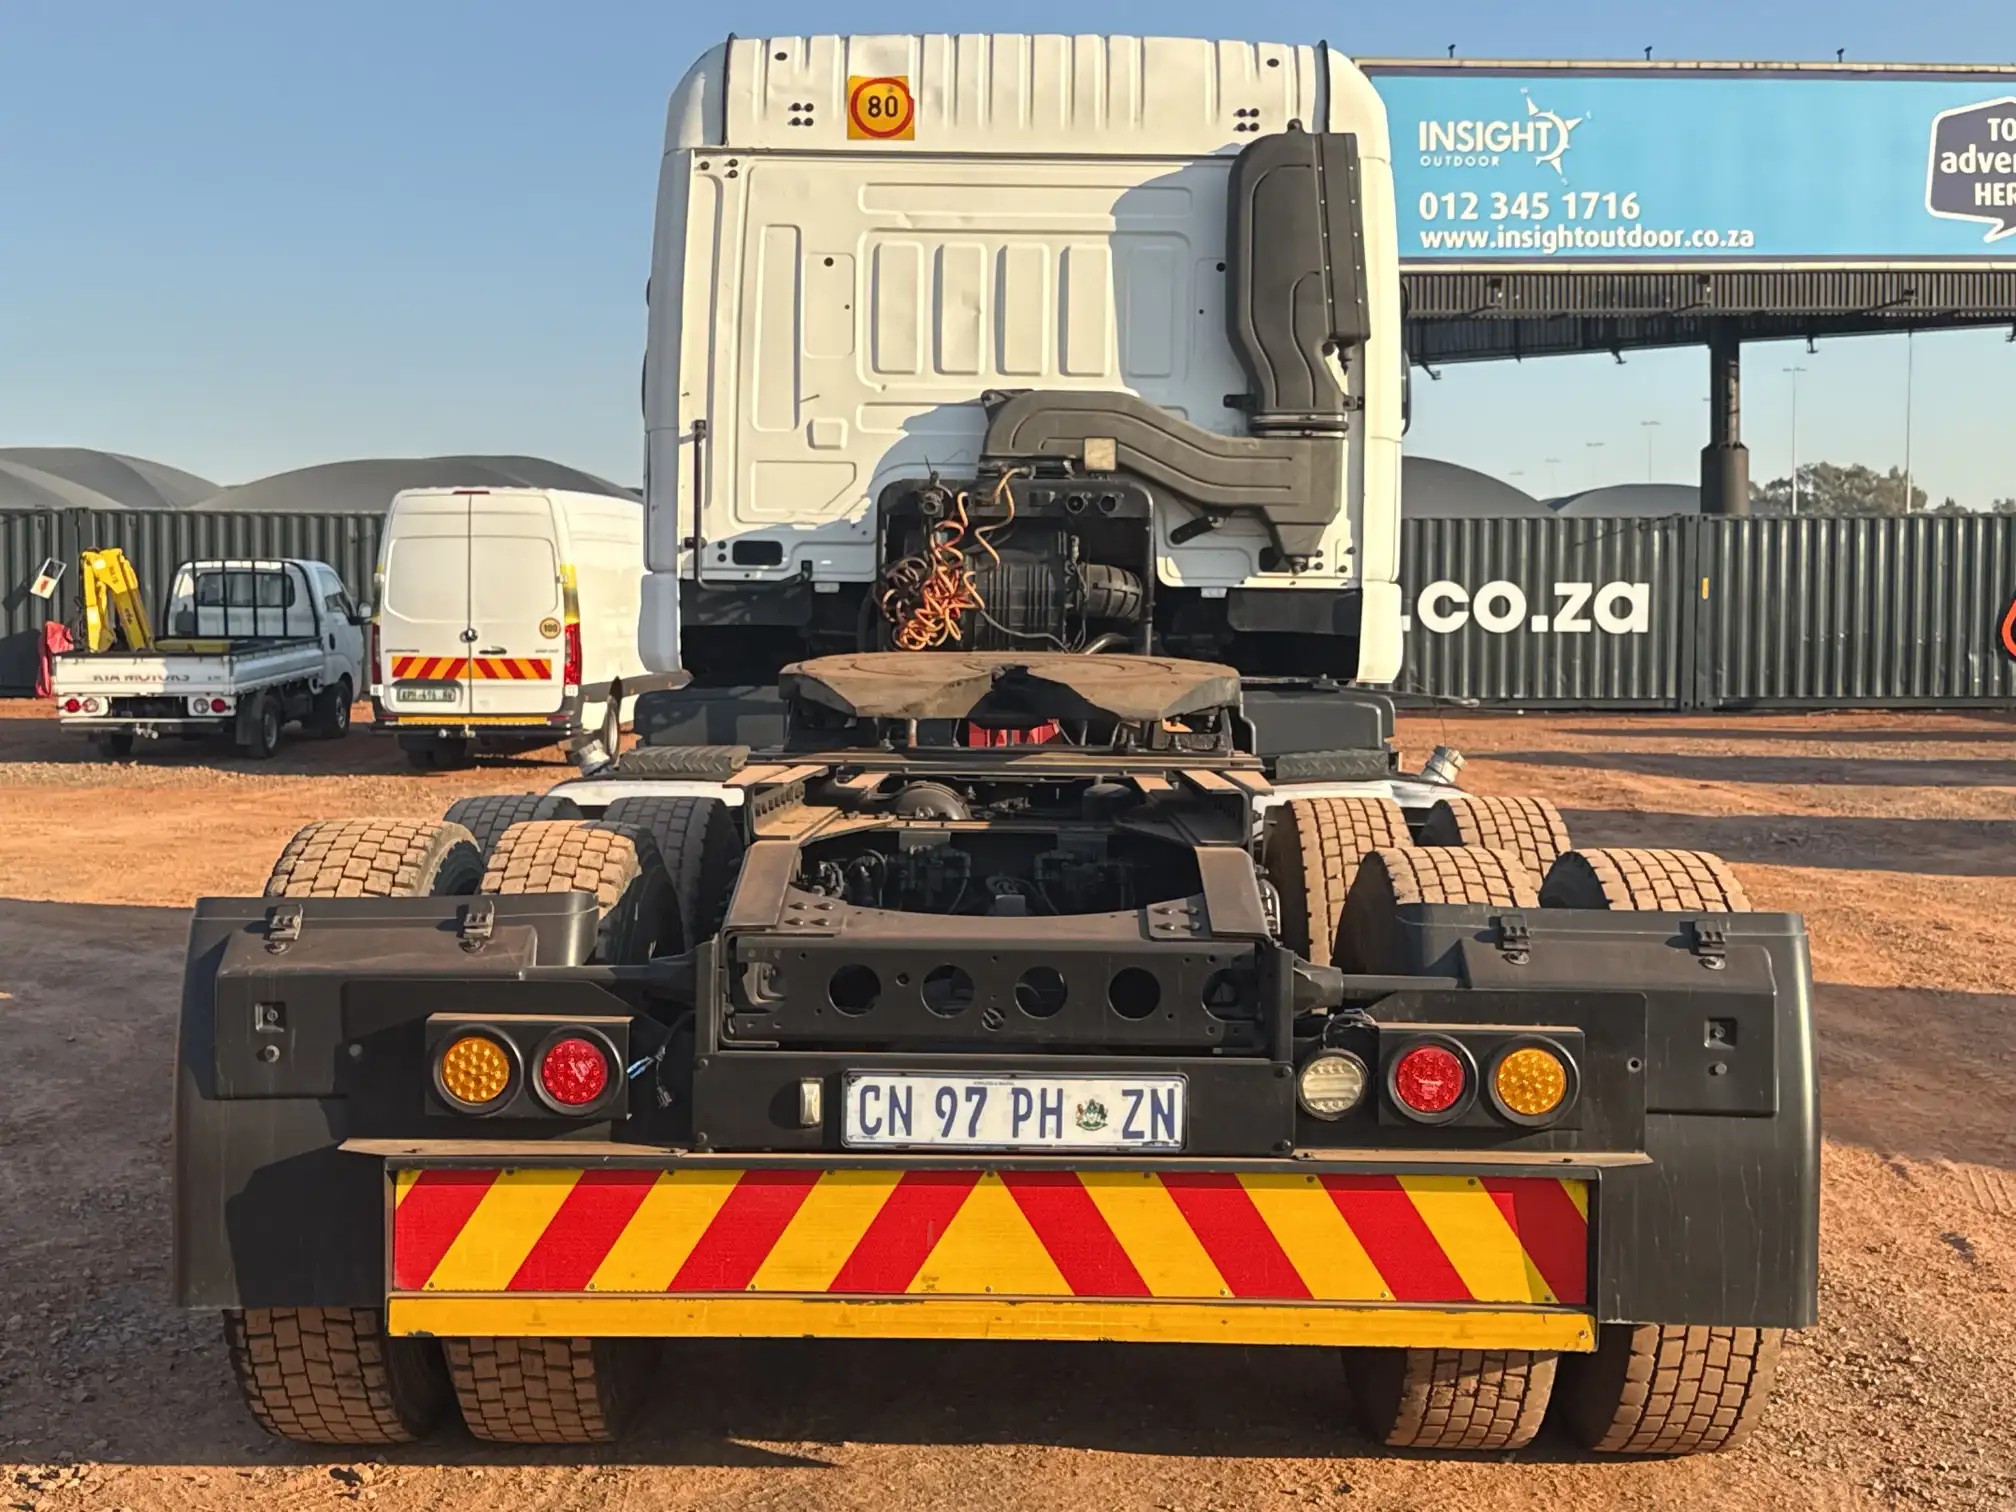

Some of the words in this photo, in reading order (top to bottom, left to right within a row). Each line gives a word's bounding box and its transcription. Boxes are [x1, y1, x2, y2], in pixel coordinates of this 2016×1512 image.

[868, 95, 898, 118] 80
[1418, 121, 1553, 152] INSIGHT
[1420, 155, 1499, 168] OUTDOOR
[1418, 192, 1479, 220] 012
[1490, 192, 1549, 220] 345
[1561, 192, 1640, 220] 1716
[1419, 224, 1755, 254] www.insightoutdoor.co.za
[859, 1084, 913, 1137] CN
[935, 1086, 988, 1138] 97
[1011, 1087, 1064, 1139] PH
[1121, 1088, 1176, 1140] ZN
